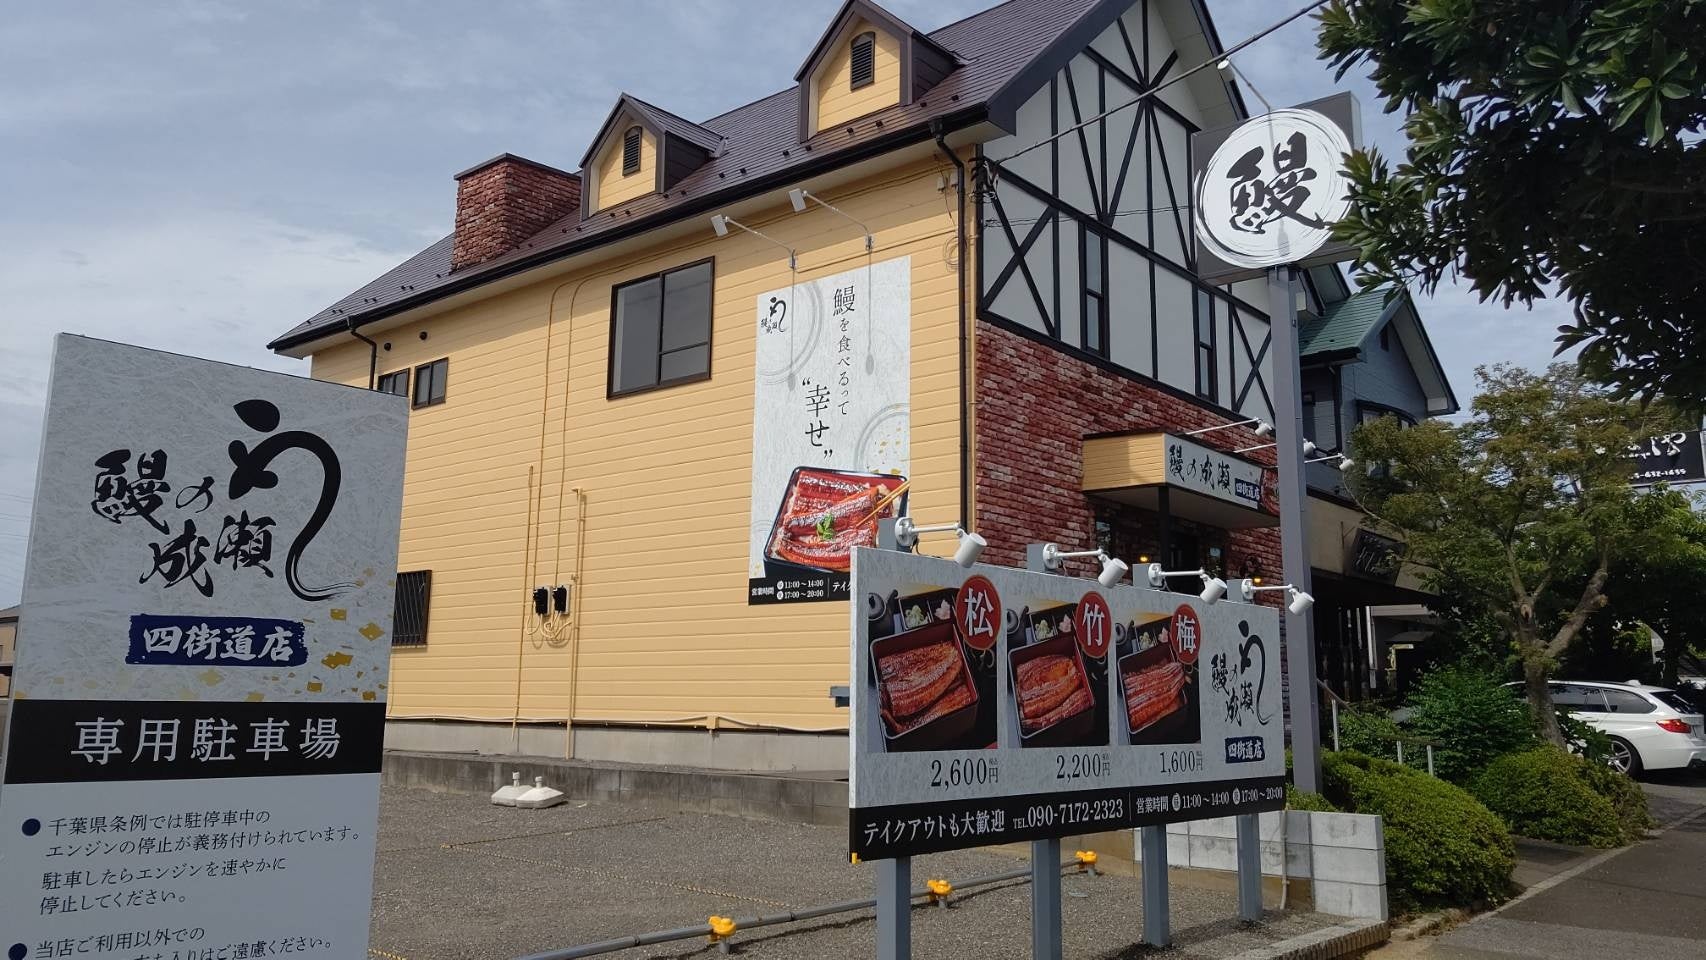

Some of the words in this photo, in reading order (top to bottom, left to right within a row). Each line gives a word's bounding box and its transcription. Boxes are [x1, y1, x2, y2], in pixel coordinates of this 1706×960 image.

[833, 285, 856, 415] 鰻を食べるって
[964, 587, 993, 637] 松
[1082, 602, 1105, 646] 竹
[143, 619, 297, 663] 四街道店
[1176, 613, 1197, 654] 梅
[70, 716, 343, 766] 専用駐車場
[47, 809, 271, 837] 千葉県条例では駐停車中の
[1136, 795, 1169, 814] 営業時間
[45, 825, 360, 859] エンジンの停止が義務付けられています。
[863, 808, 1006, 848] テイクアウトも大歓迎
[41, 857, 288, 891] 駐車したらエンジンを速やかに
[39, 889, 187, 917] 停止してください。
[35, 926, 206, 959] 当店ご利用以外での
